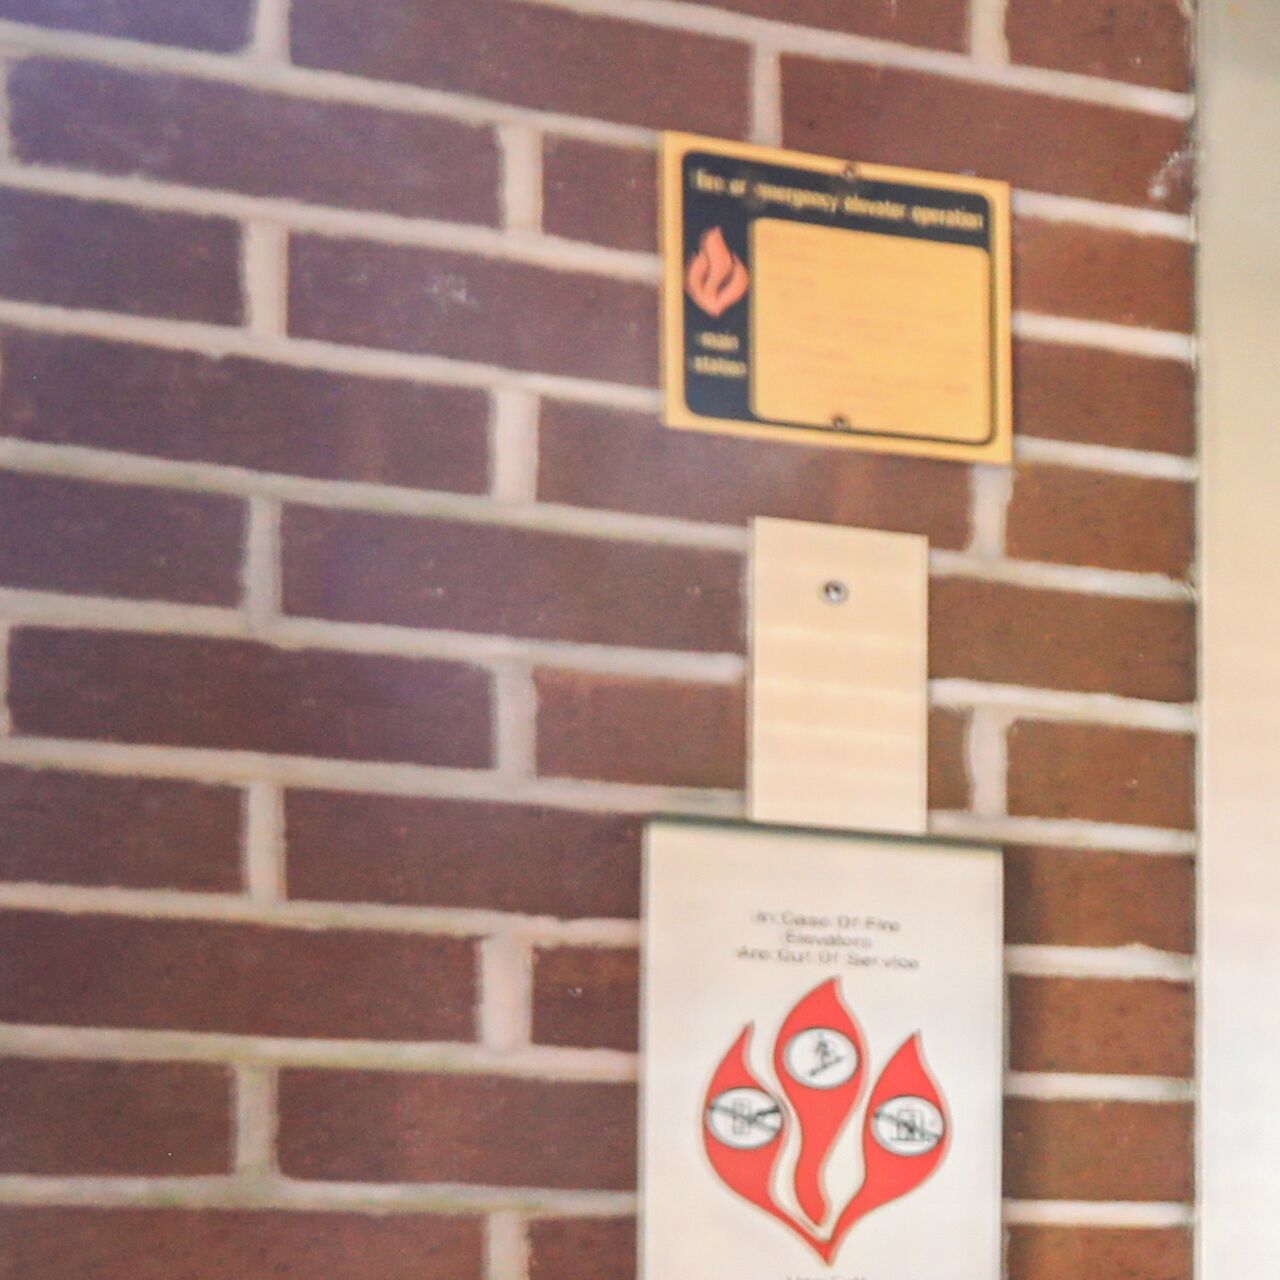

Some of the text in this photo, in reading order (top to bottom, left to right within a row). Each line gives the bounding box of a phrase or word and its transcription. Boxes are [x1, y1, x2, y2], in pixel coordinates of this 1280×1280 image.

[781, 911, 829, 928] Case
[865, 917, 900, 932] Fire
[785, 931, 872, 949] Elevators
[737, 946, 769, 961] Are
[778, 948, 811, 963] Out
[847, 953, 919, 969] Service
